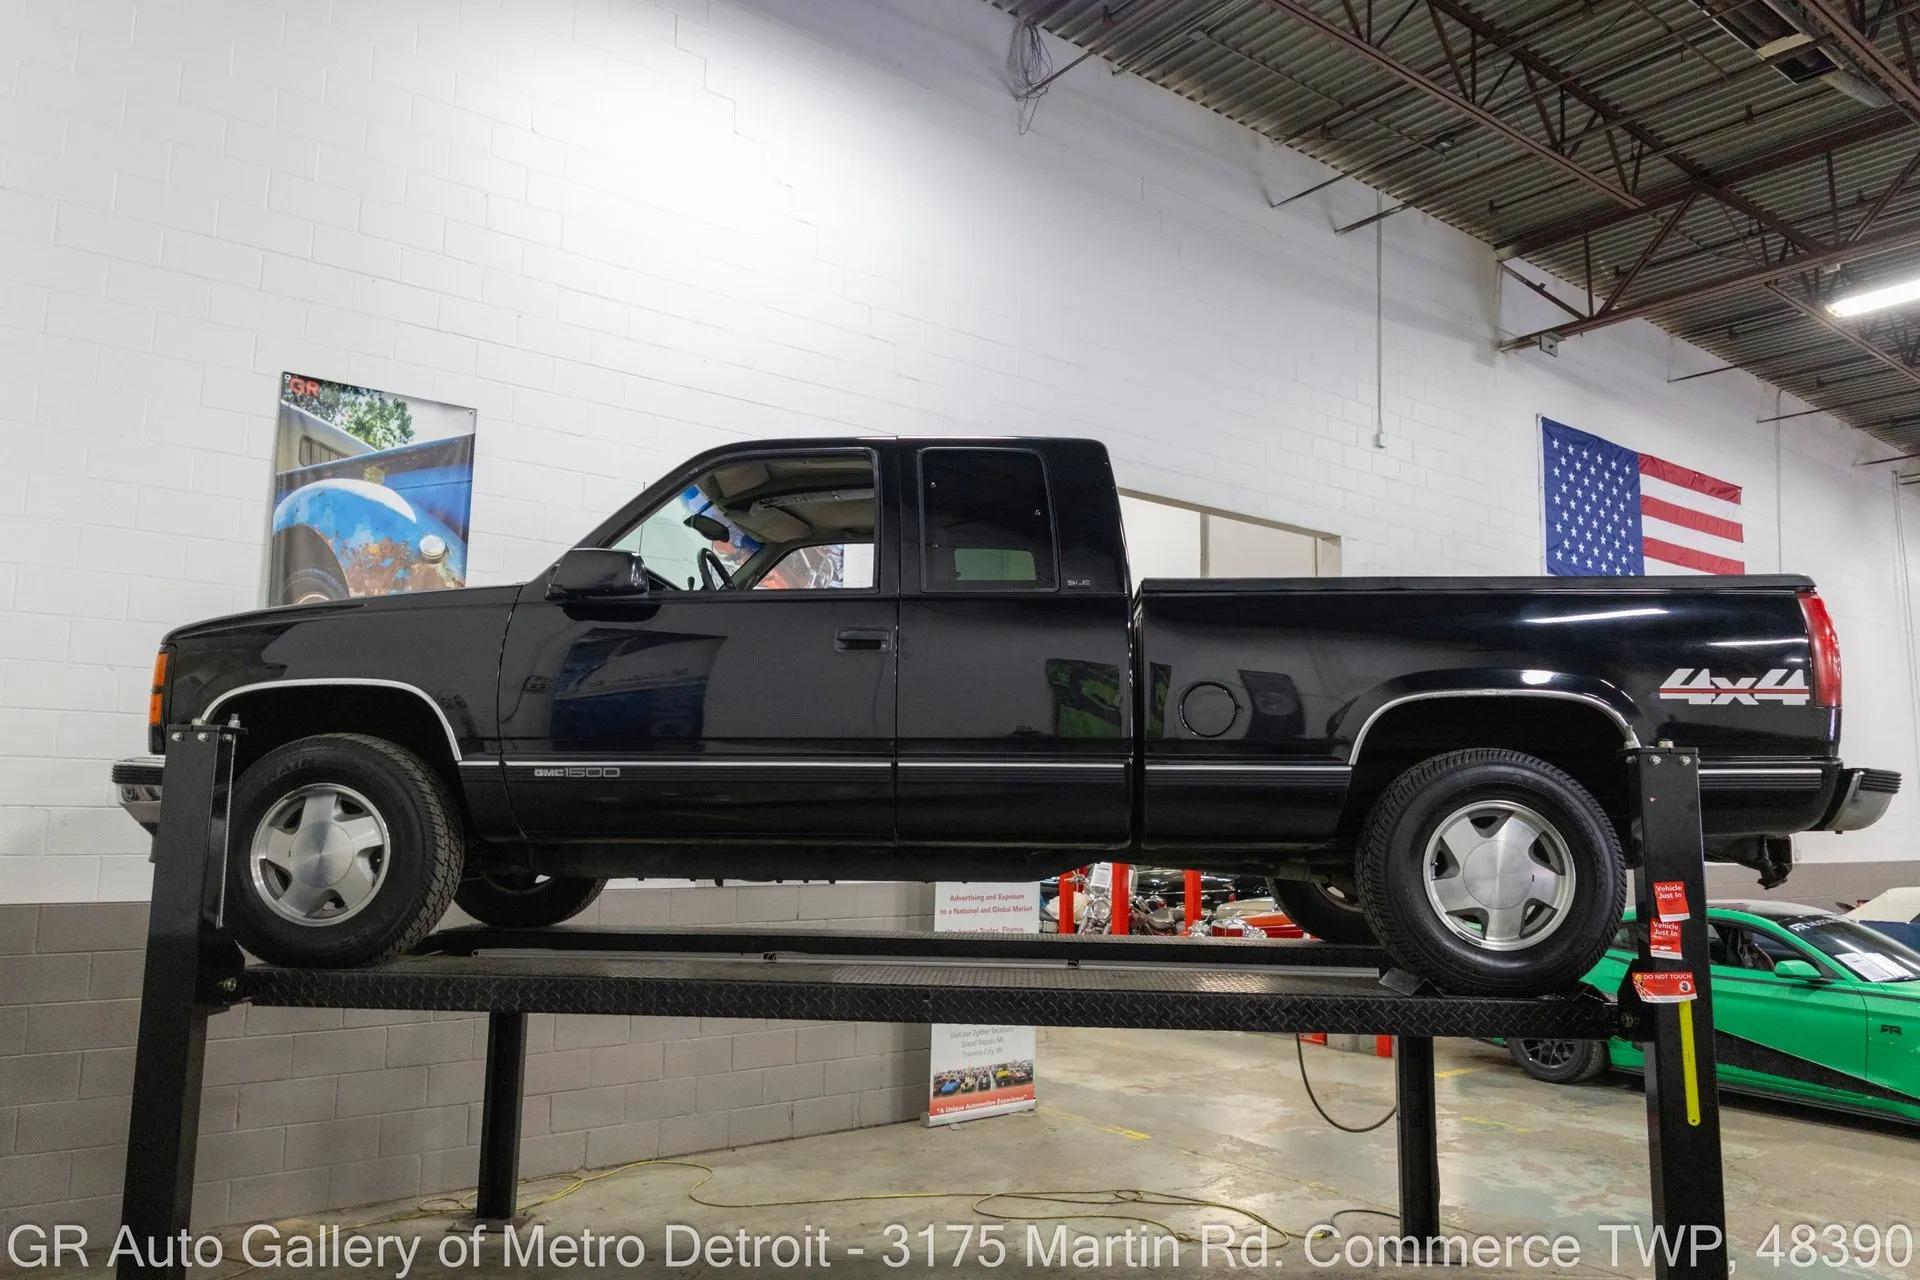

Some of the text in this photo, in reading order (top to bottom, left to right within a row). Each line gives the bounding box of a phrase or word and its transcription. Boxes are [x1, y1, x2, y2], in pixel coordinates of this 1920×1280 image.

[288, 375, 321, 398] GR
[1659, 668, 1810, 705] 4x4
[534, 767, 620, 778] GMC 1500
[1656, 884, 1682, 892] Vehicle
[950, 894, 984, 902] Advertising
[998, 894, 1024, 902] Exposure
[1658, 892, 1674, 900] Just
[1653, 921, 1679, 930] Vehicle
[966, 1100, 996, 1109] Automotive
